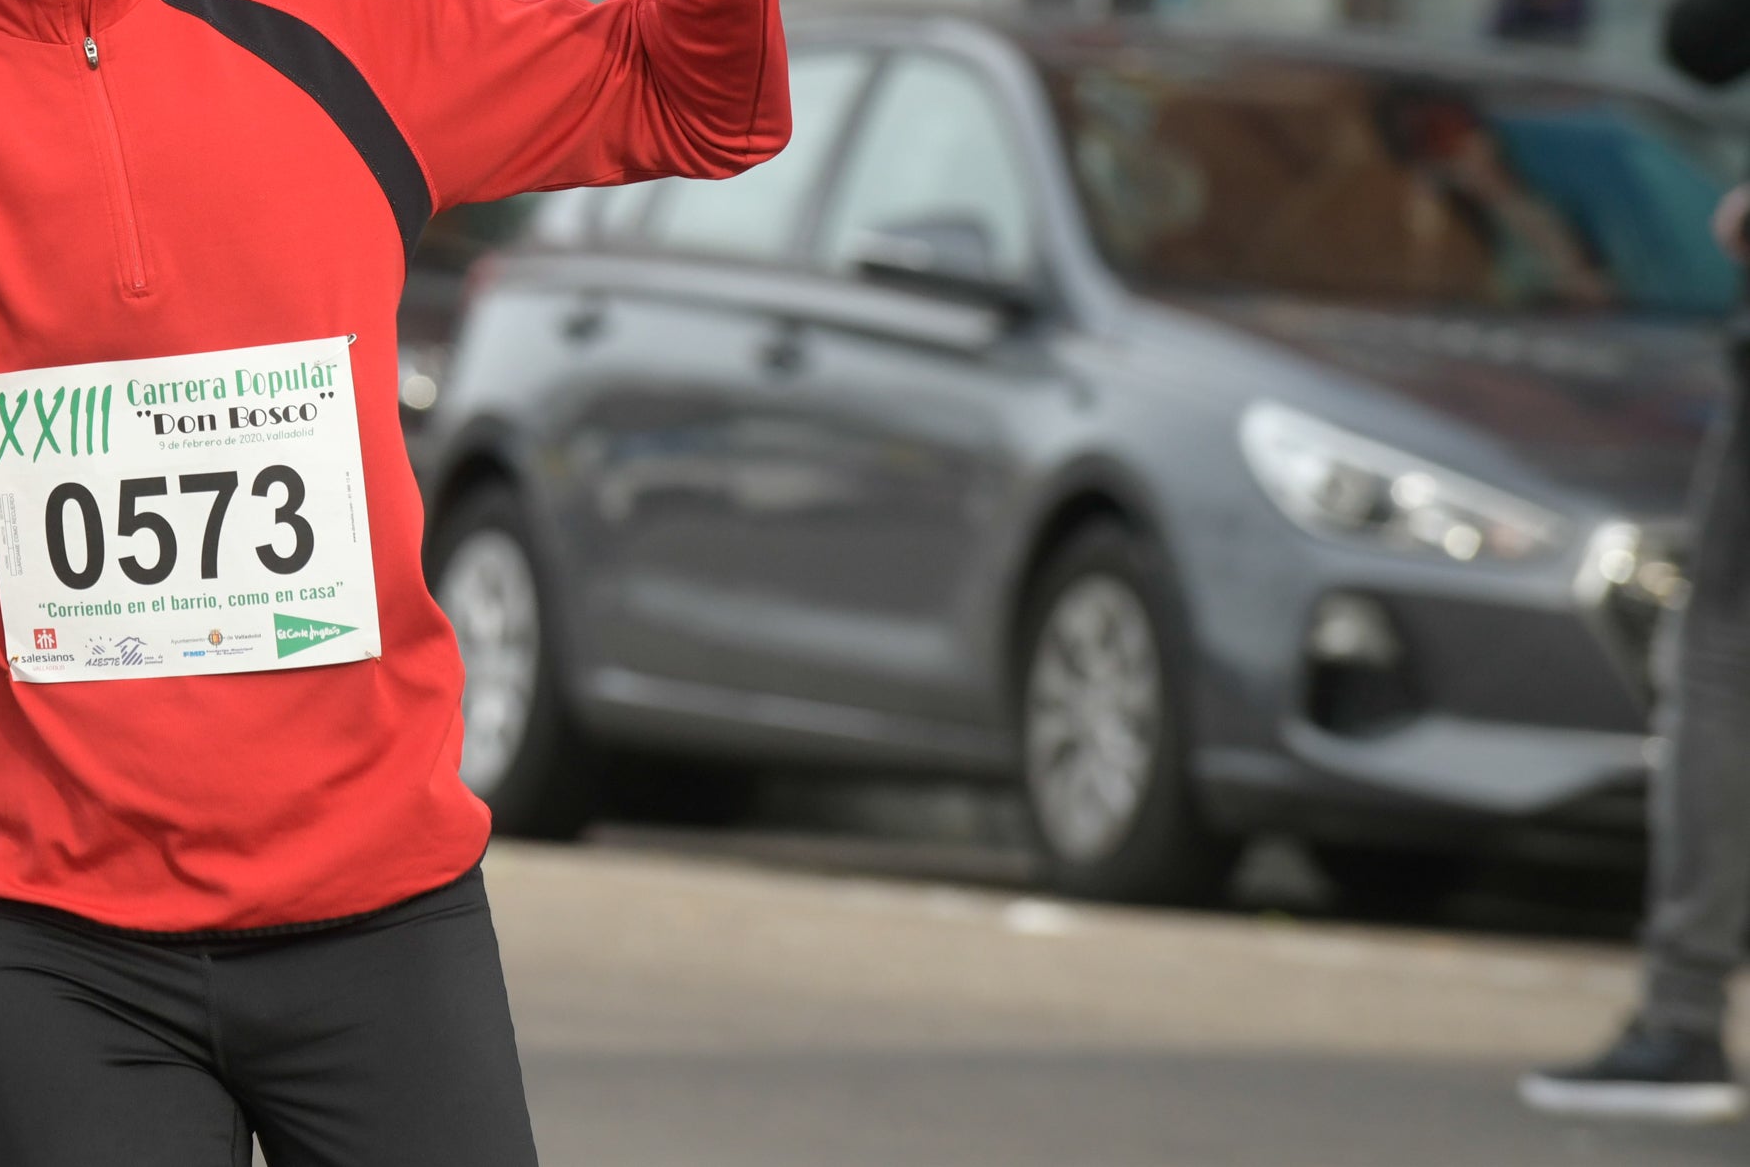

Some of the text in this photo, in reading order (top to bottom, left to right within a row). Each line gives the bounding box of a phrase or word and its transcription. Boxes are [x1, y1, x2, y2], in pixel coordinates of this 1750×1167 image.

[126, 377, 227, 406] Carrera
[234, 362, 338, 399] Popular
[158, 441, 165, 451] 9
[168, 440, 180, 450] de
[182, 438, 222, 449] febrero
[225, 435, 236, 445] de
[266, 428, 314, 442] Valladolid
[45, 464, 315, 590] 0573
[127, 601, 146, 614] en
[152, 596, 165, 611] el
[171, 593, 222, 611] barrio,
[228, 591, 269, 607] como
[275, 590, 293, 603] en
[21, 653, 75, 663] salesianos
[85, 657, 120, 667] ALESTE
